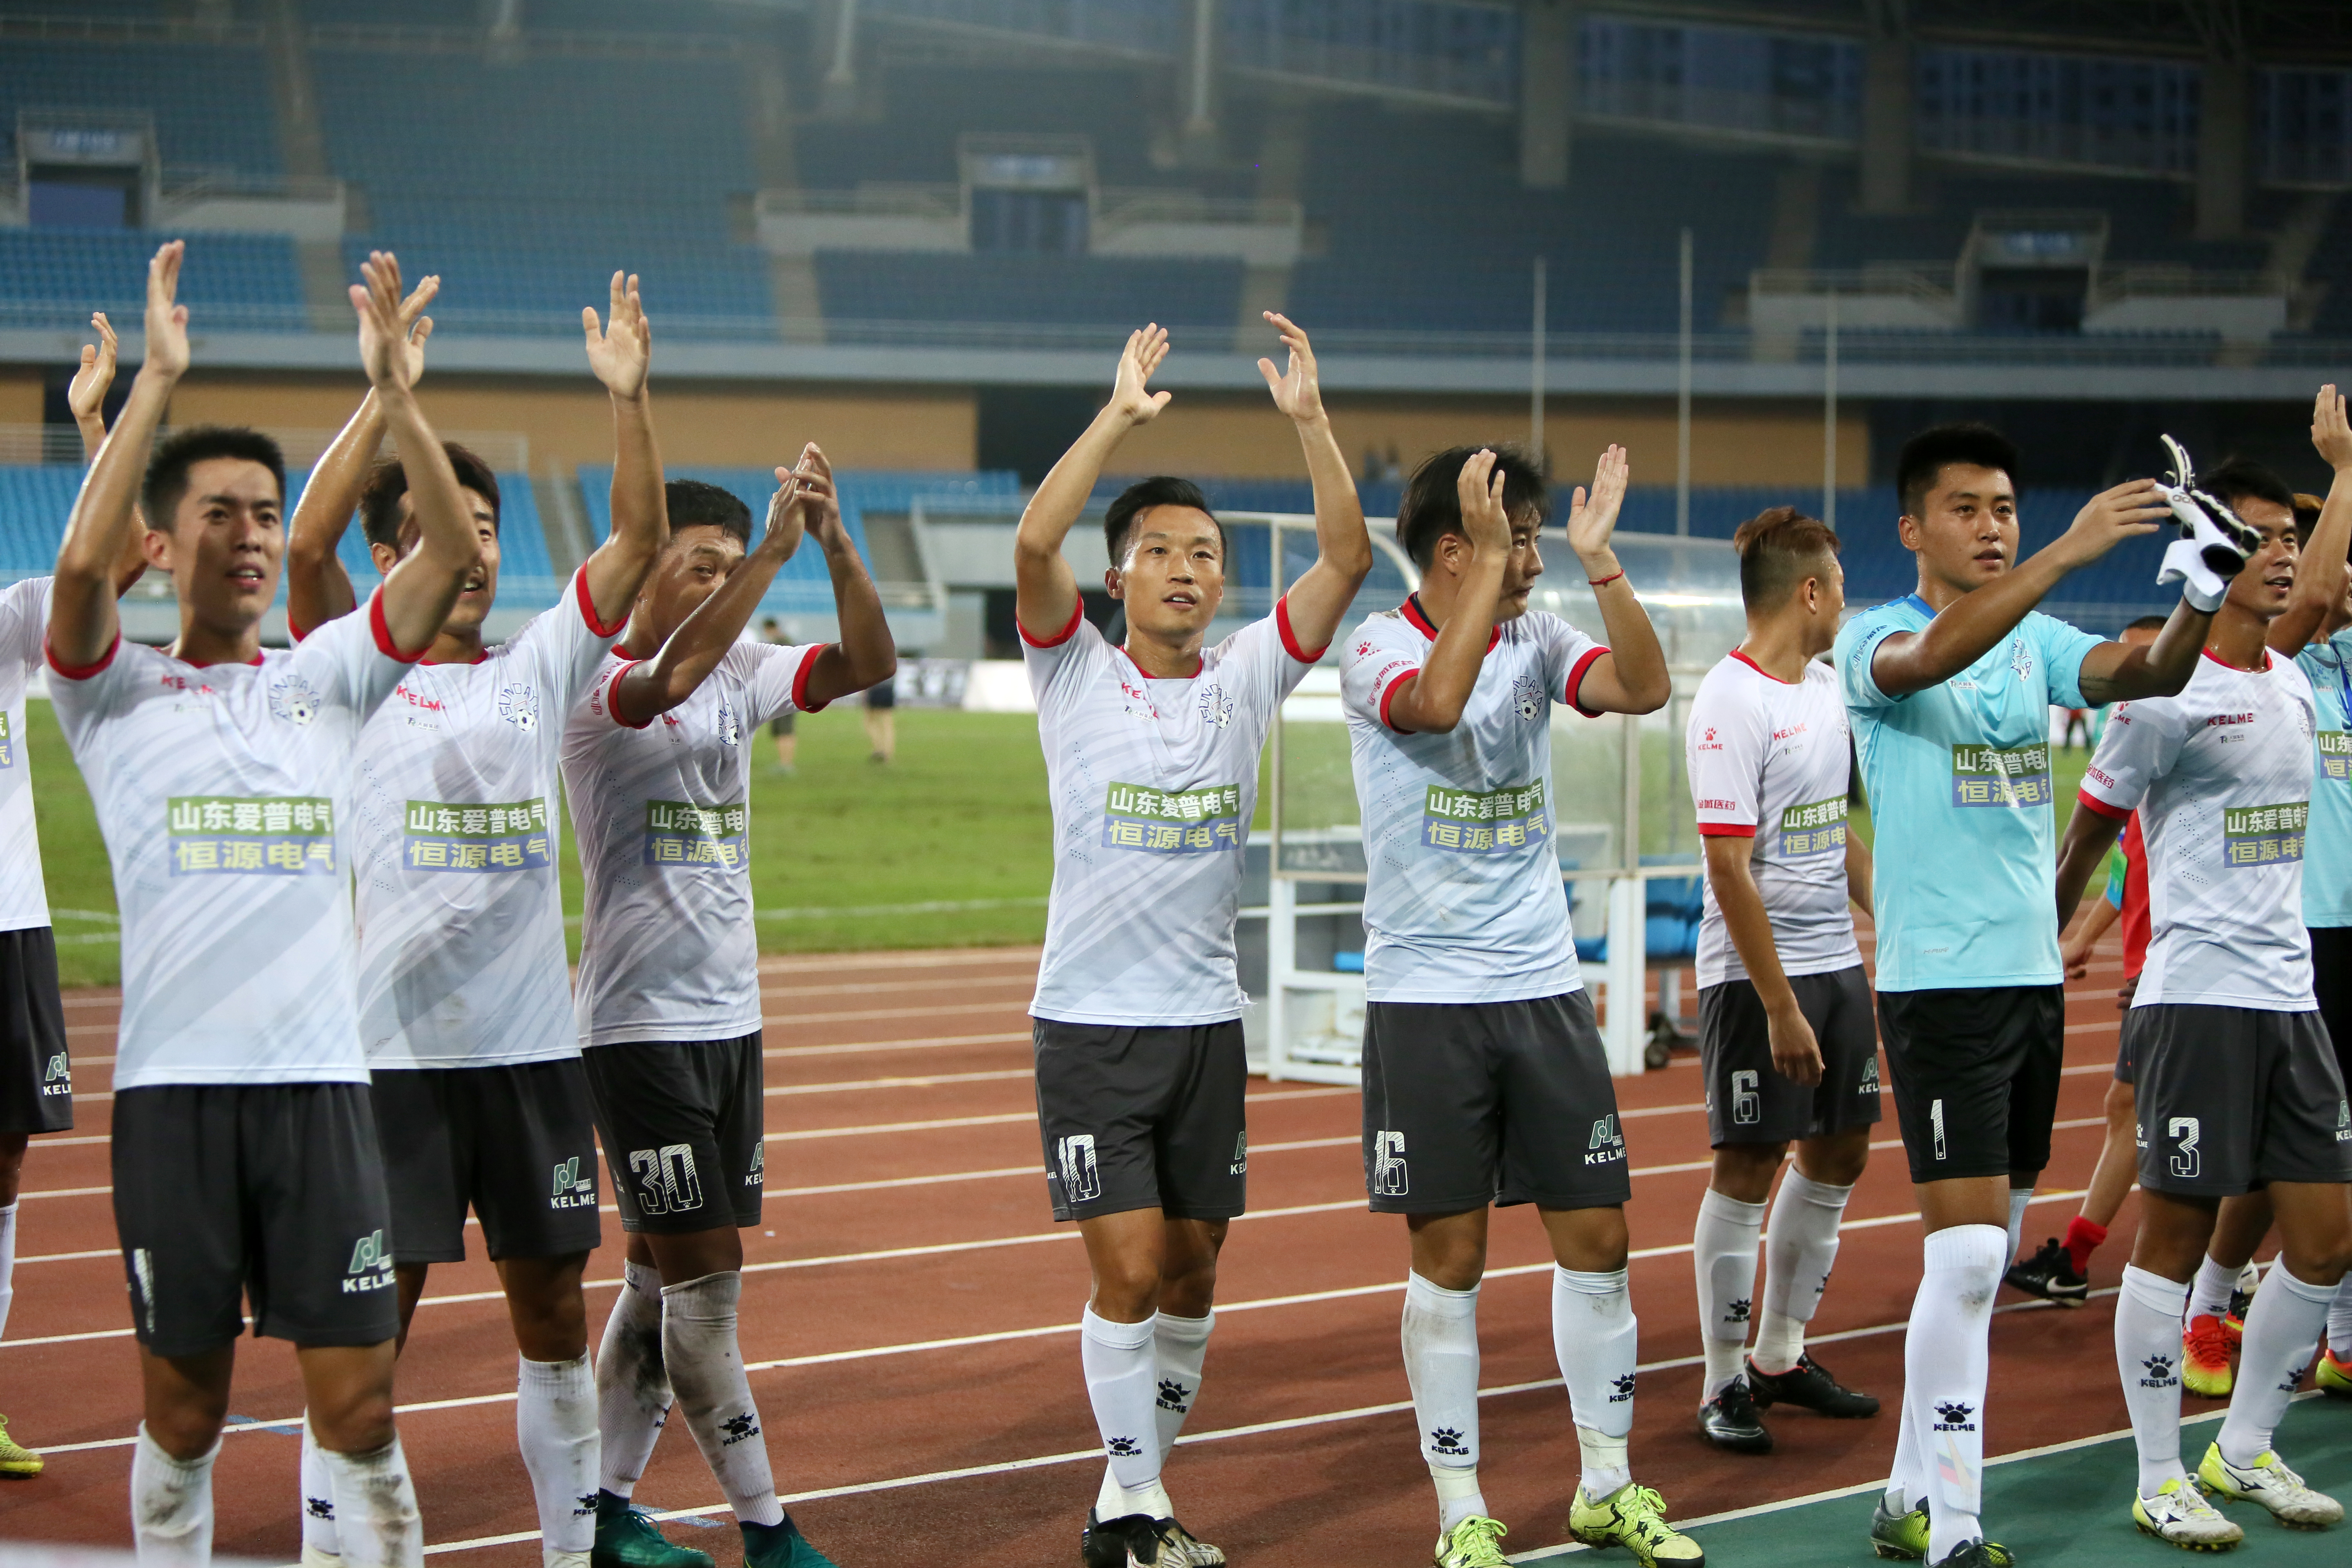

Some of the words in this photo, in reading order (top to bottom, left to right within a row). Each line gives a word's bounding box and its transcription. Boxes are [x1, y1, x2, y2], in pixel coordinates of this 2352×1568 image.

[396, 685, 446, 711] KELM
[1773, 722, 1807, 741] KELME
[2207, 713, 2254, 726] KELME
[172, 801, 332, 832] 山东爱普电气
[1111, 787, 1237, 818] 山东爱普电气
[1430, 783, 1542, 820] 山东爱普电气
[410, 804, 546, 834] 山东爱普电气
[1428, 814, 1547, 850] 恒源电气
[1109, 820, 1238, 849] 恒源电气
[176, 840, 334, 871] 恒源电气
[409, 838, 550, 869] 恒源电气
[1732, 1070, 1760, 1125] 6
[1931, 1099, 1946, 1160] 1
[1585, 1147, 1626, 1165] KELME
[2169, 1117, 2199, 1177] 3
[1058, 1134, 1100, 1203] 10
[1230, 1160, 1247, 1175] KEL
[1374, 1130, 1409, 1196] 16
[629, 1143, 704, 1214] 30
[745, 1171, 764, 1186] KEL
[551, 1193, 595, 1209] KELME
[2140, 1376, 2177, 1388] KELME
[722, 1426, 760, 1447] KELME
[1934, 1423, 1975, 1432] KELME
[1432, 1445, 1469, 1455] KELME
